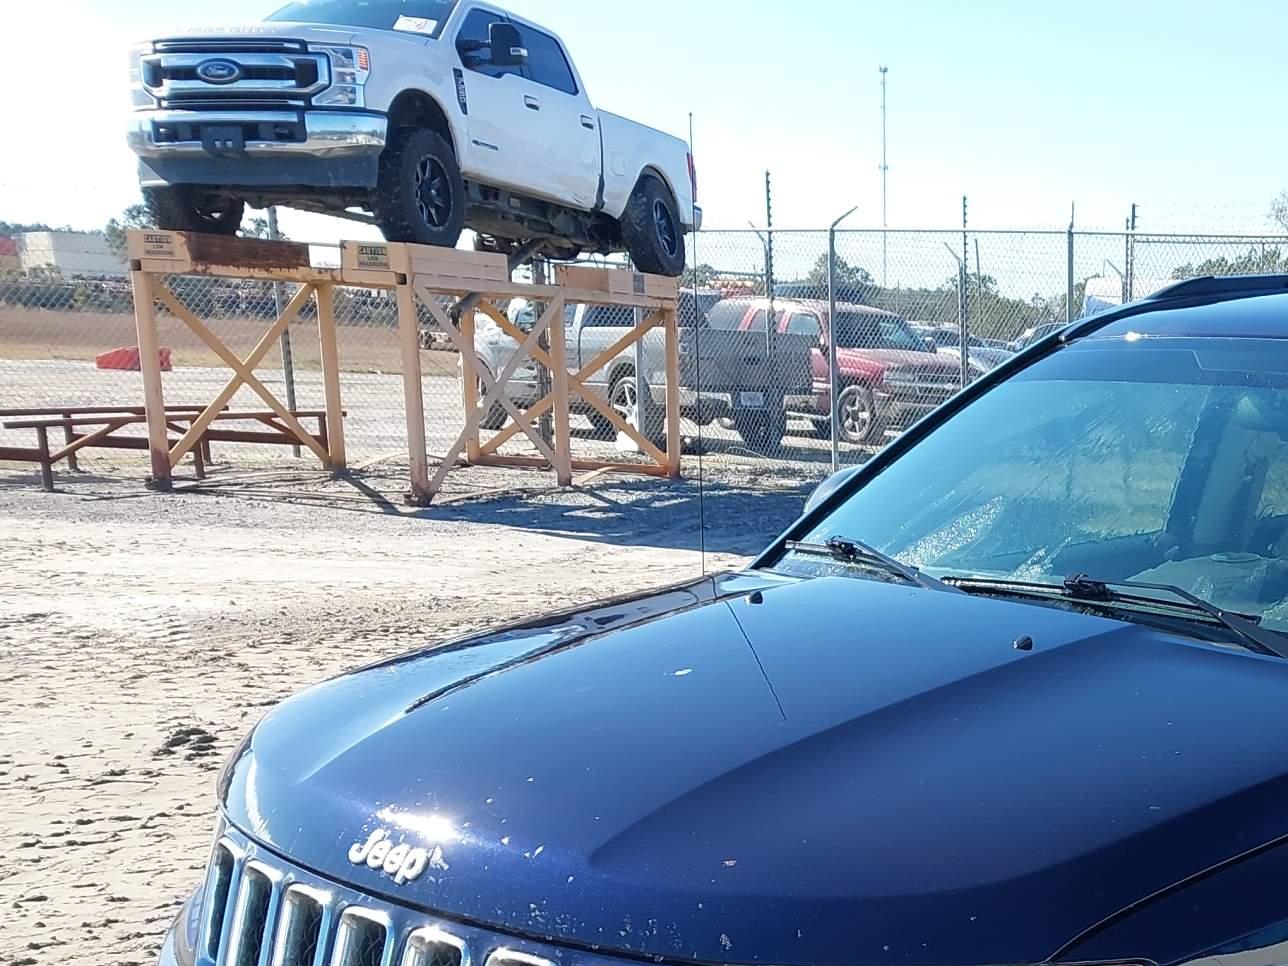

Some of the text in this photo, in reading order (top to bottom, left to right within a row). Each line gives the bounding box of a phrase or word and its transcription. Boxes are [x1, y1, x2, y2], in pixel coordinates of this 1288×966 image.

[144, 234, 172, 243] CAUTION
[358, 246, 387, 255] CAUTION
[348, 828, 429, 886] Jeep
